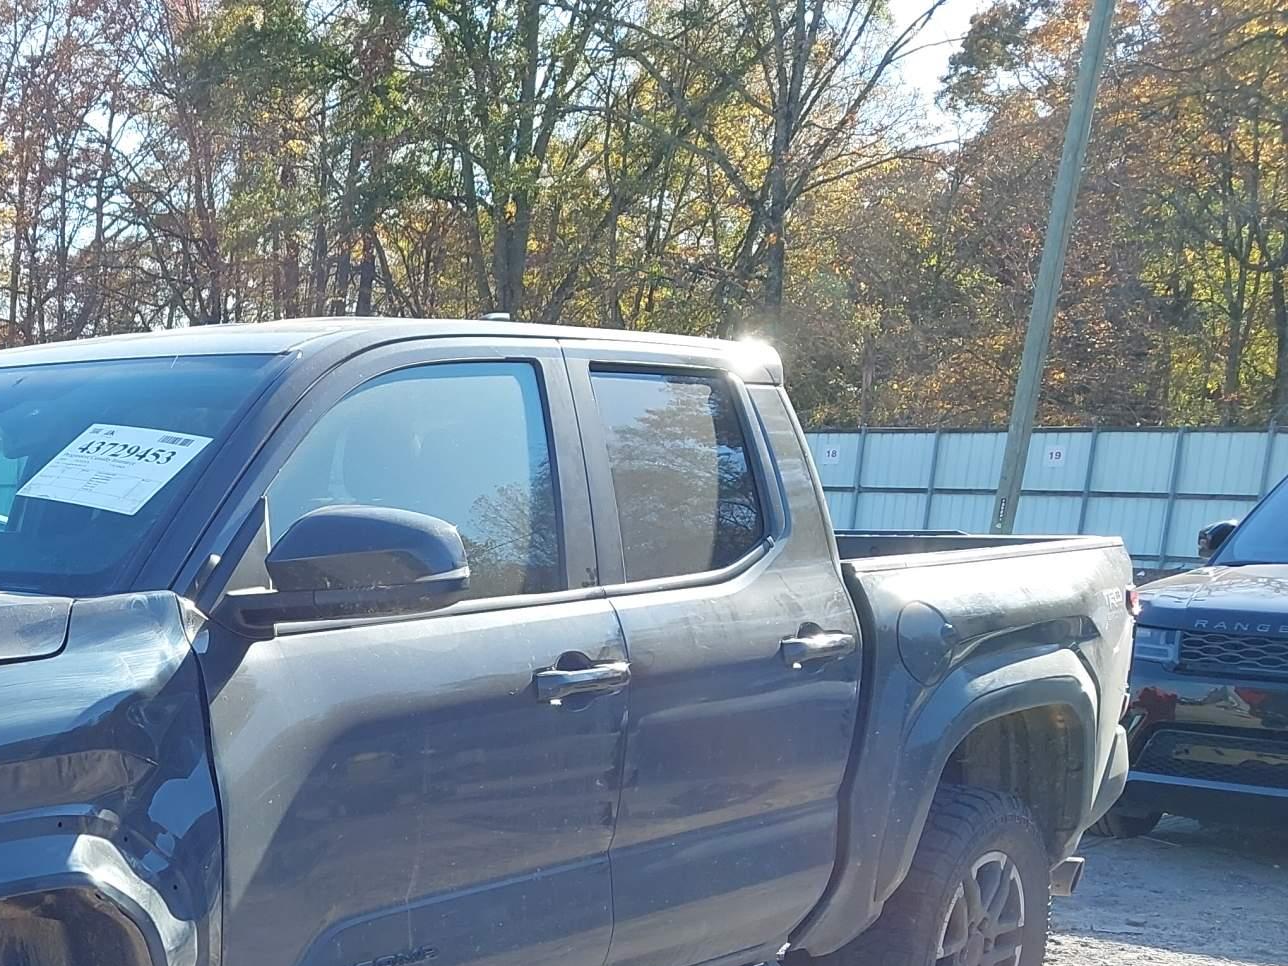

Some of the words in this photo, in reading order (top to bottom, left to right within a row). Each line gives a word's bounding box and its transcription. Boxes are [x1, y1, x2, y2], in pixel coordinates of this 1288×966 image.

[78, 440, 177, 465] 43729453
[825, 449, 838, 459] 18
[1048, 450, 1062, 460] 19
